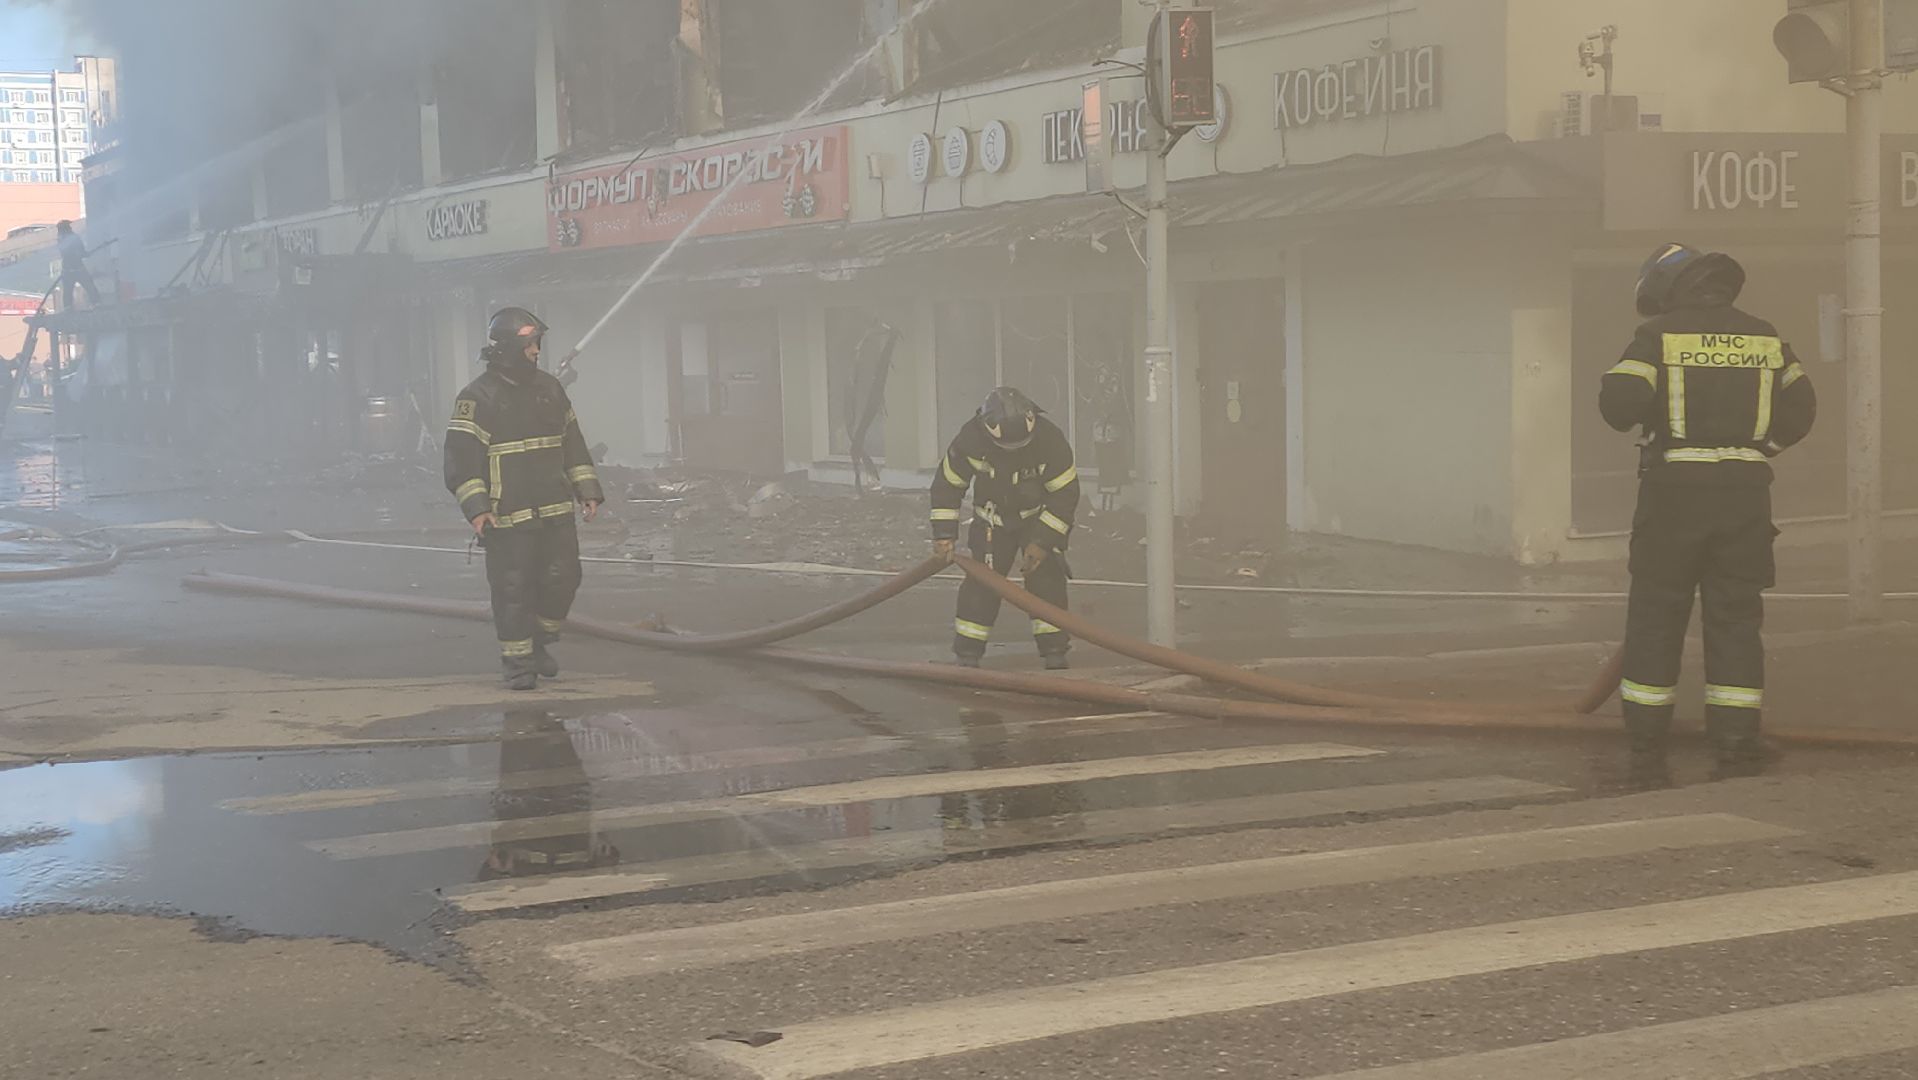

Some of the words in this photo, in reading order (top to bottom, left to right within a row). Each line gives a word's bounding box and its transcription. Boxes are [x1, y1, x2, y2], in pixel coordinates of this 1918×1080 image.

[1273, 38, 1433, 129] КОФЕЙНЯ
[1042, 97, 1146, 162] ПЕКРНЯ
[1693, 151, 1799, 210] КОФЕ
[425, 200, 482, 240] КАРАОКЕ
[1680, 352, 1768, 367] РОССИИ
[1701, 335, 1745, 348] МЧС
